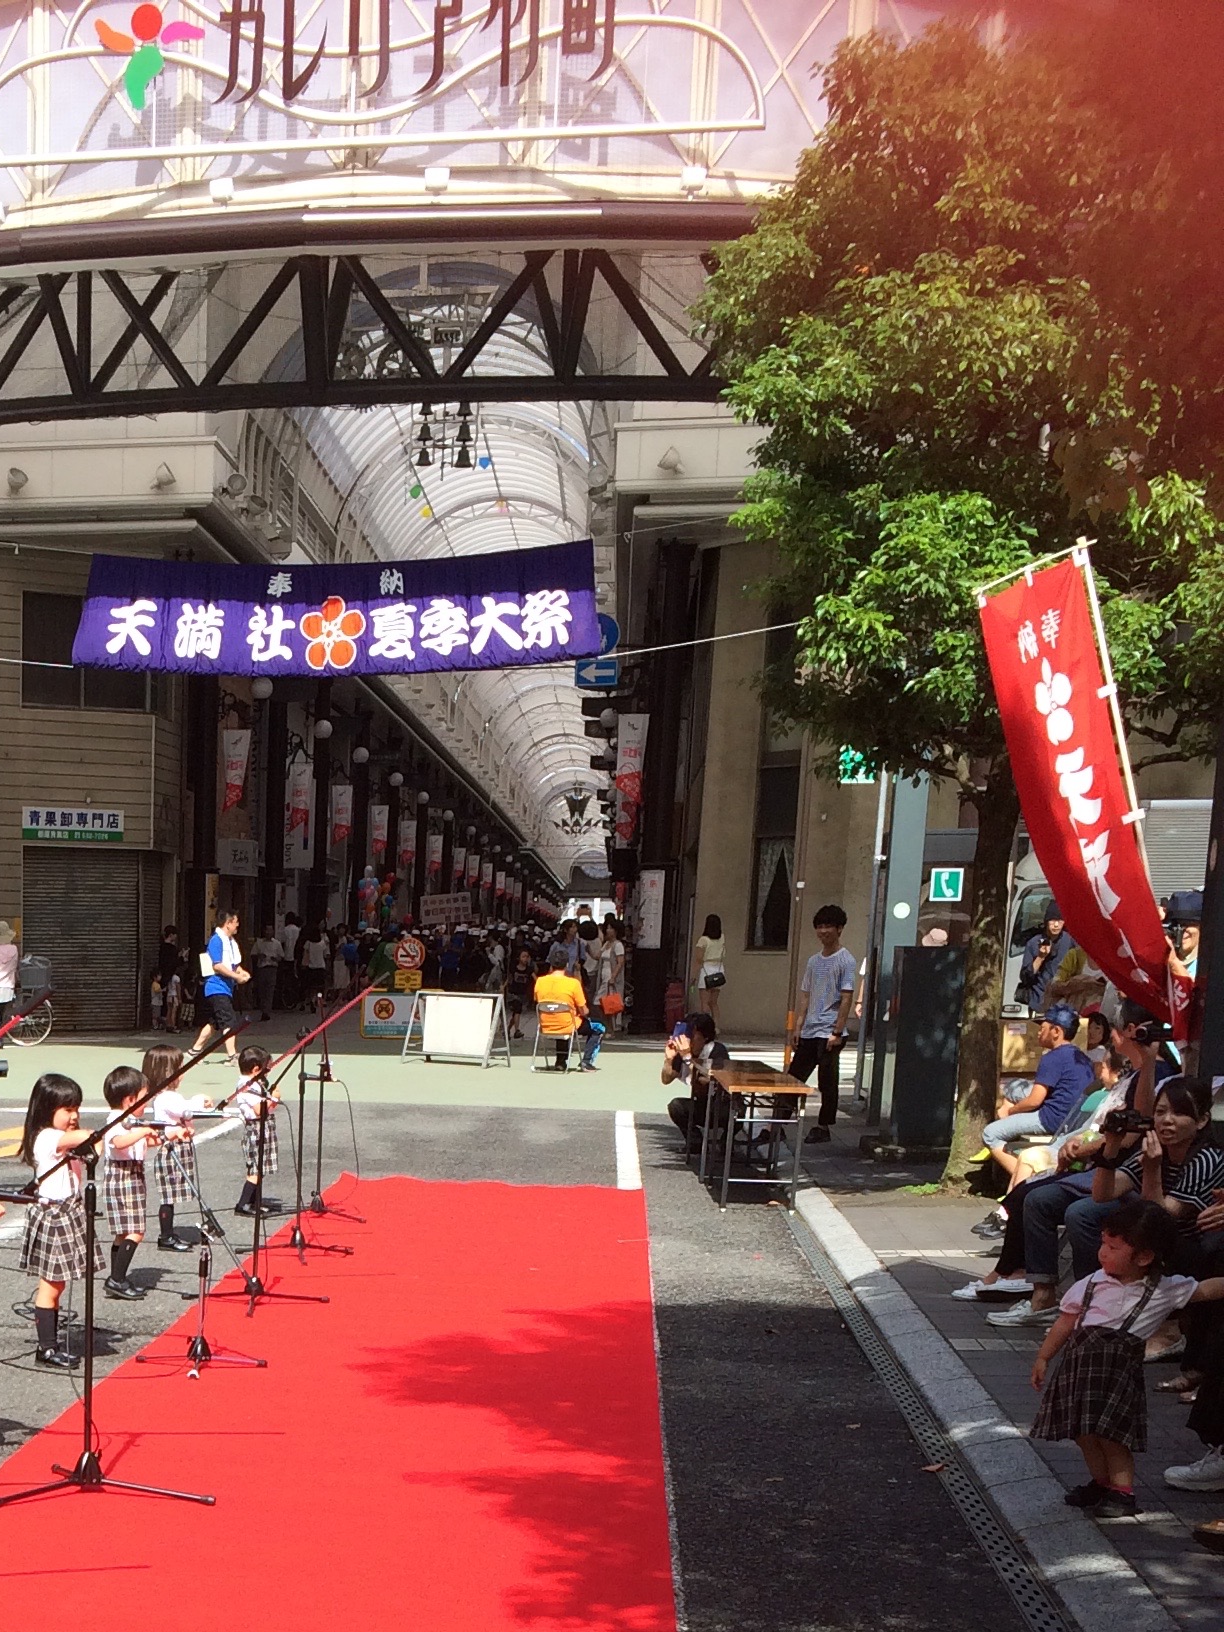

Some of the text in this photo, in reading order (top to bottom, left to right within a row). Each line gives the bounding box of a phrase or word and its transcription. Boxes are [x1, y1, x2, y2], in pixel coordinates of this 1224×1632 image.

[105, 588, 573, 662] 天満社 夏季大祭
